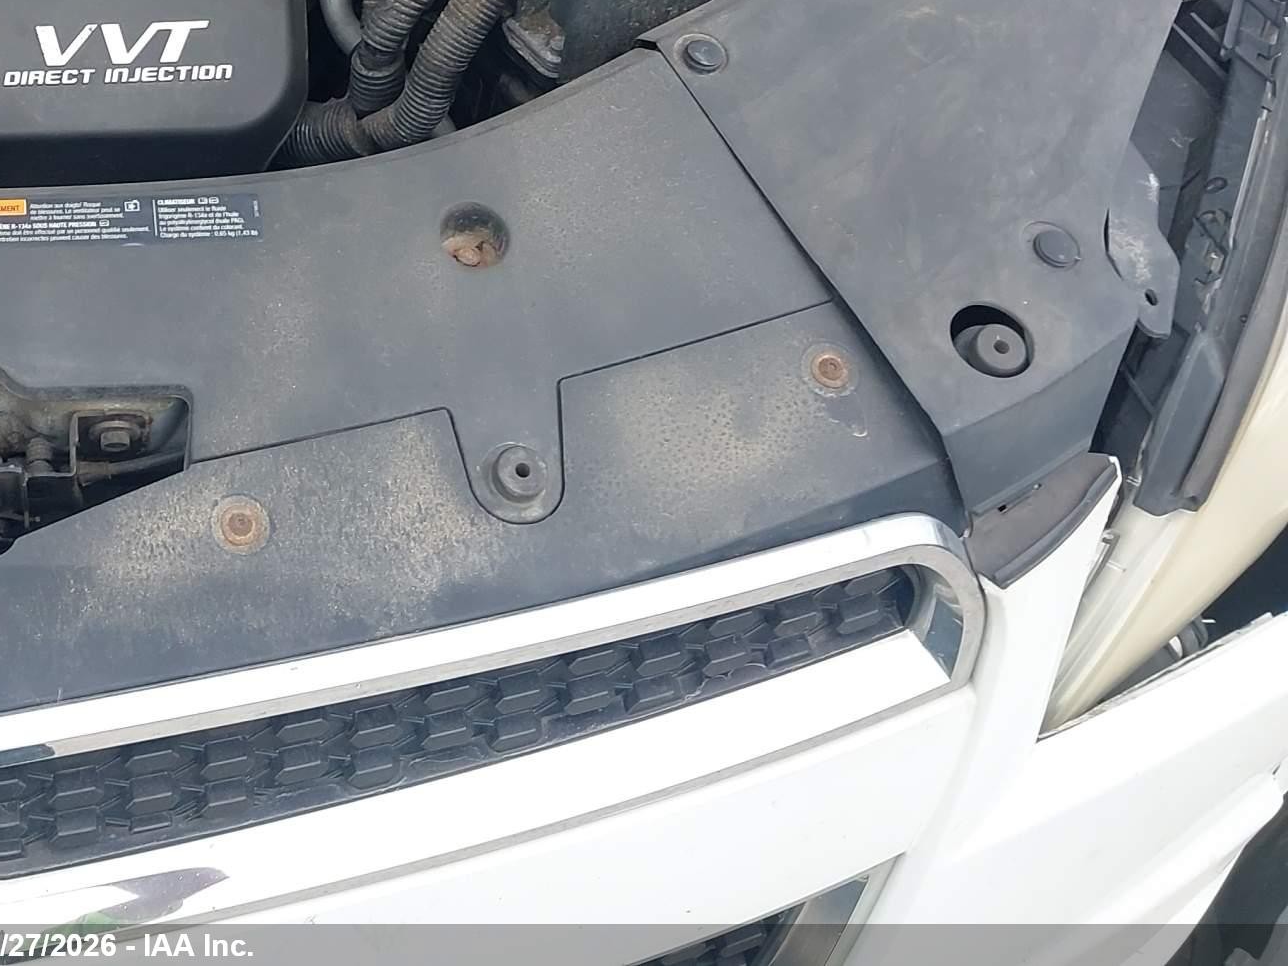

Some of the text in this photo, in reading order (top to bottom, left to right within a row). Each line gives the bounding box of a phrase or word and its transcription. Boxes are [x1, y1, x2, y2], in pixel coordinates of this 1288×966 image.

[34, 19, 210, 66] VVT
[2, 63, 233, 87] DIRECT INJECTION
